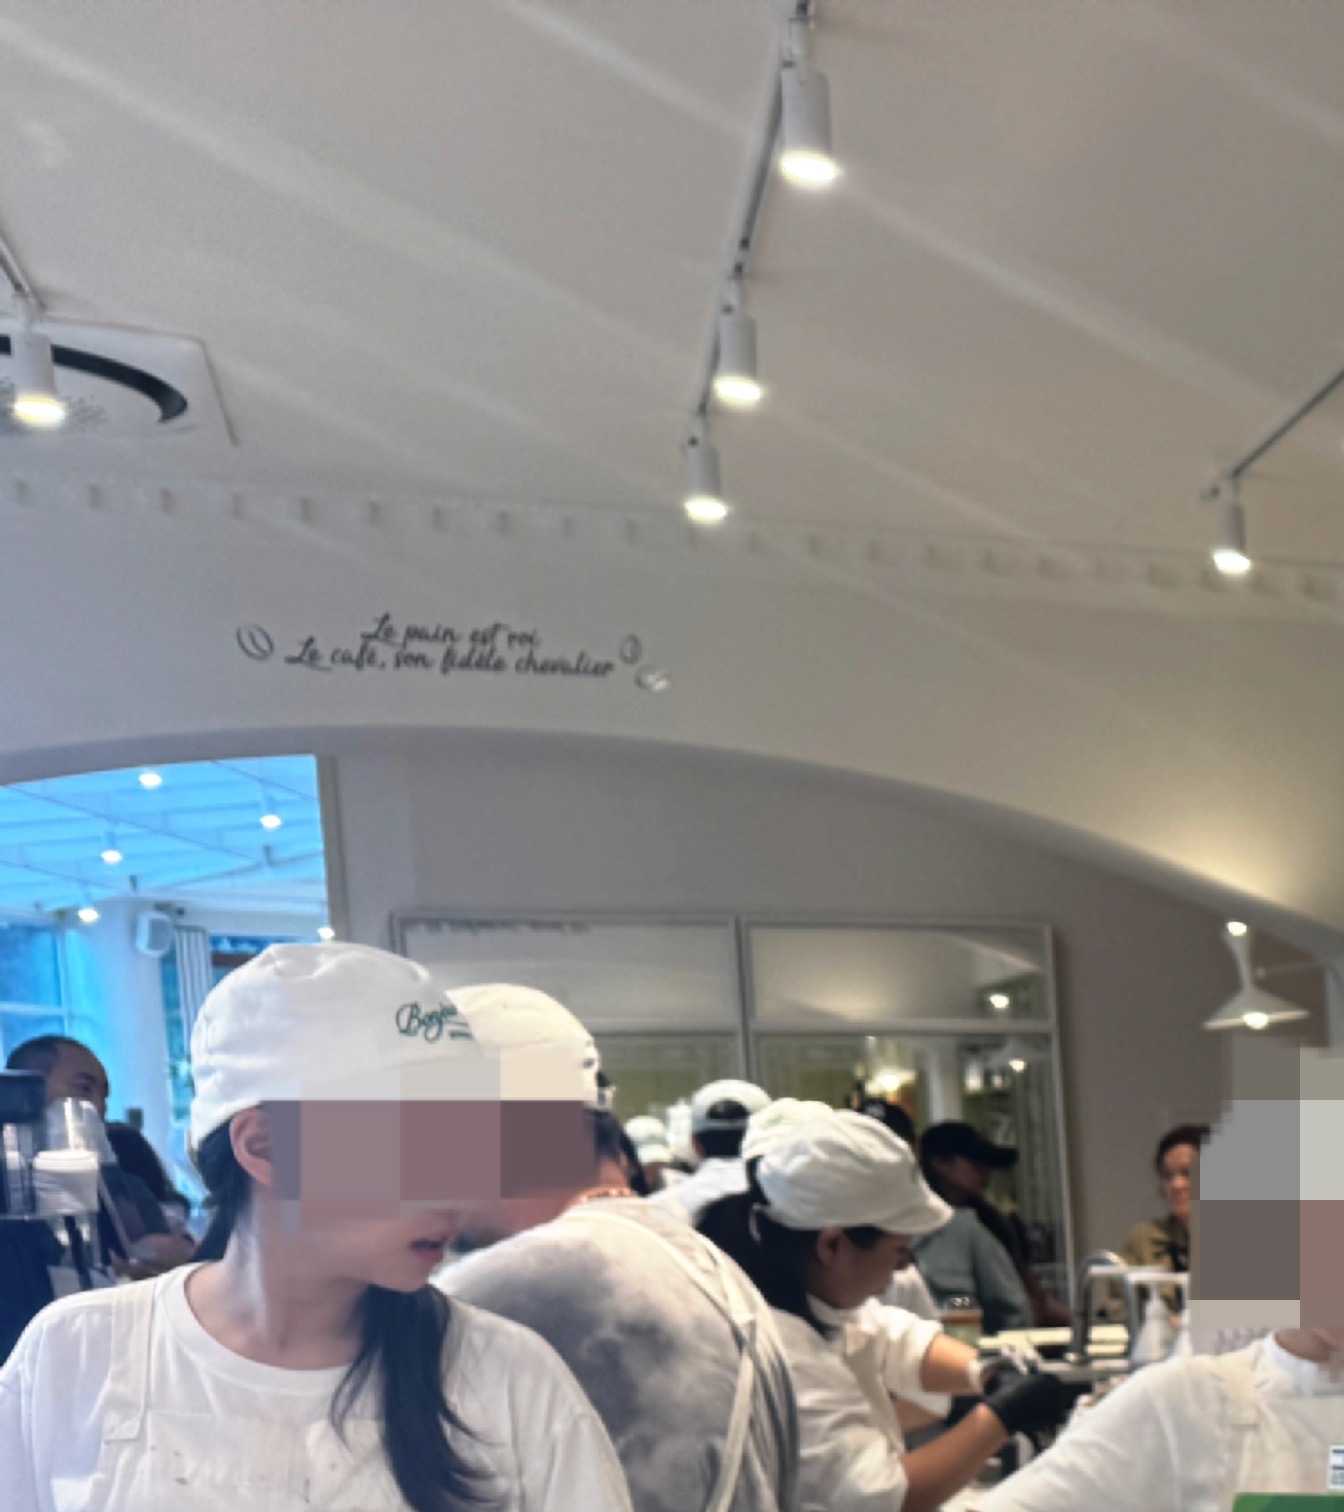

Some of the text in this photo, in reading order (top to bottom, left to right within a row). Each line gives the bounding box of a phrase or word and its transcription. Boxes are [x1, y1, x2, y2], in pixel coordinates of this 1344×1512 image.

[403, 619, 460, 650] pain
[469, 621, 511, 646] est
[394, 647, 431, 670] son
[514, 648, 616, 677] chevalier
